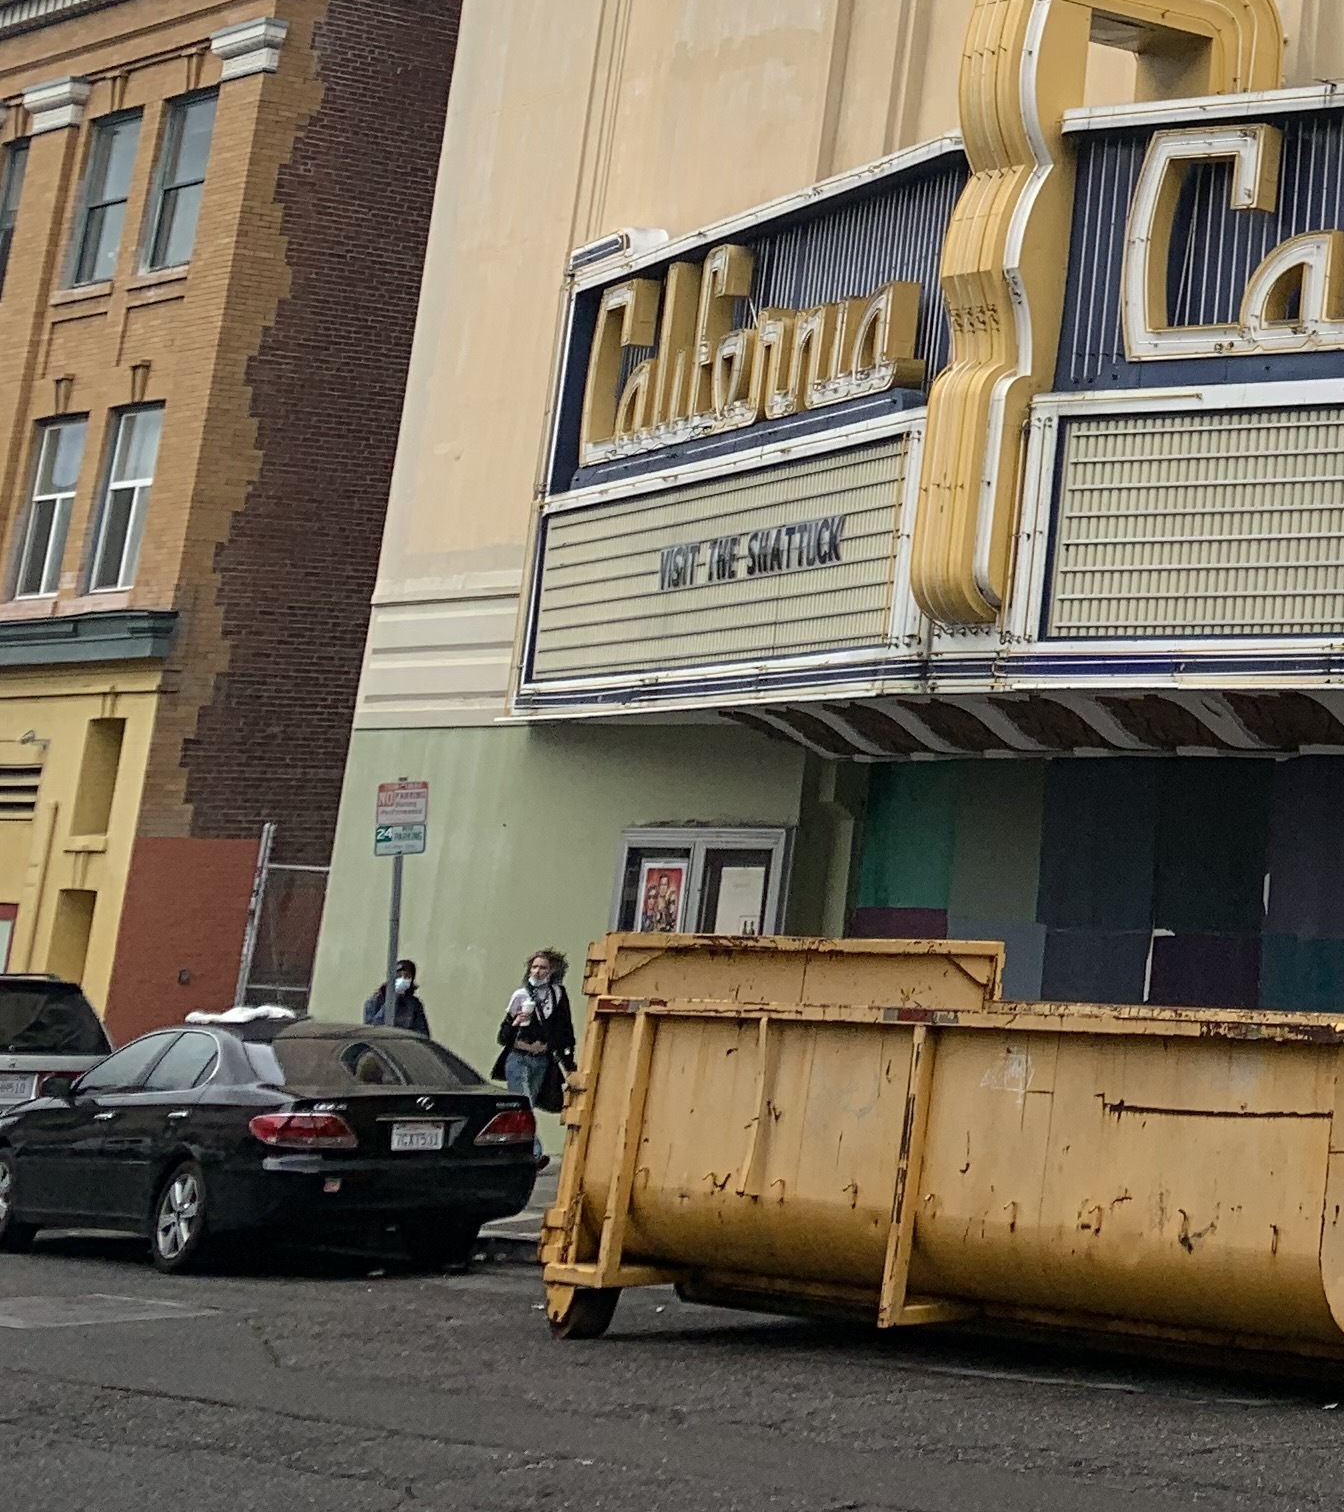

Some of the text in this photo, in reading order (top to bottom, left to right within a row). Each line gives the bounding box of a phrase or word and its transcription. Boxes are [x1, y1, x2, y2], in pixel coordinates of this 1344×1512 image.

[660, 515, 847, 591] VISIT THE SHATTUCK
[378, 792, 394, 807] NO
[376, 828, 392, 840] 24
